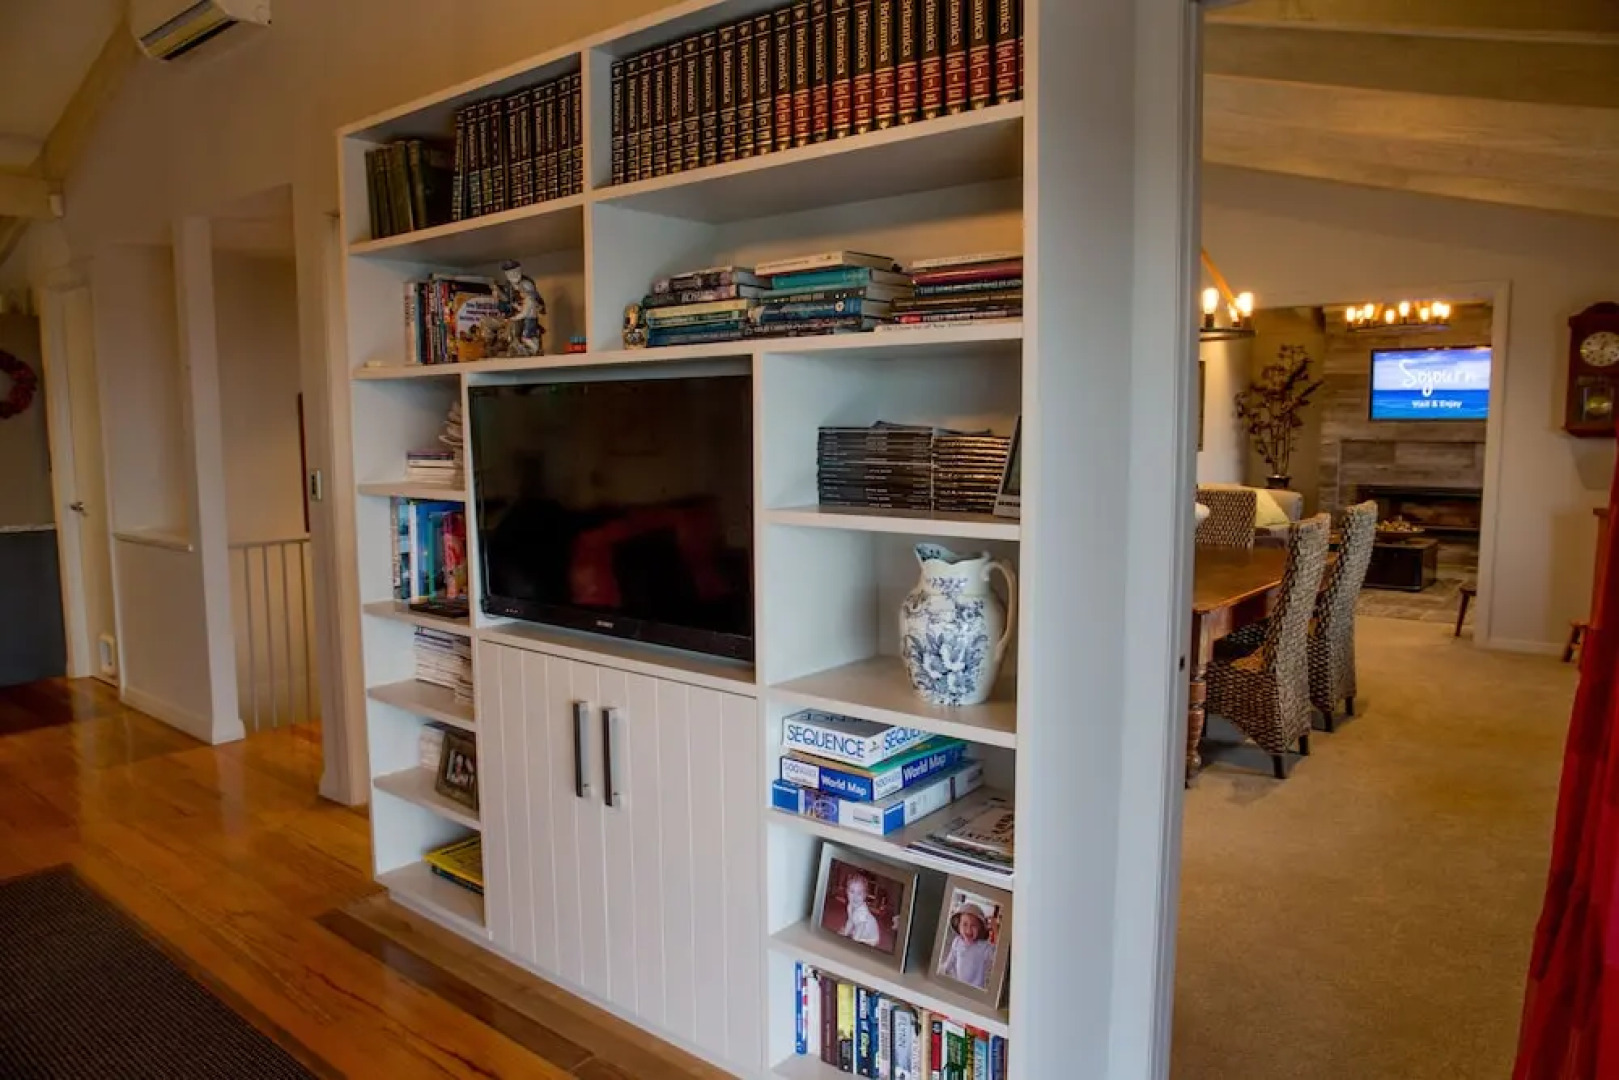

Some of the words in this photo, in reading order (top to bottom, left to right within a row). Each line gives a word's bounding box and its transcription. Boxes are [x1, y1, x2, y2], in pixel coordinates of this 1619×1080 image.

[857, 9, 868, 69] Britannica
[1398, 358, 1477, 398] Sojourn
[787, 724, 865, 759] SEQUENCE
[821, 774, 846, 791] World
[847, 781, 867, 797] Map
[903, 760, 929, 783] World
[928, 753, 947, 772] Map
